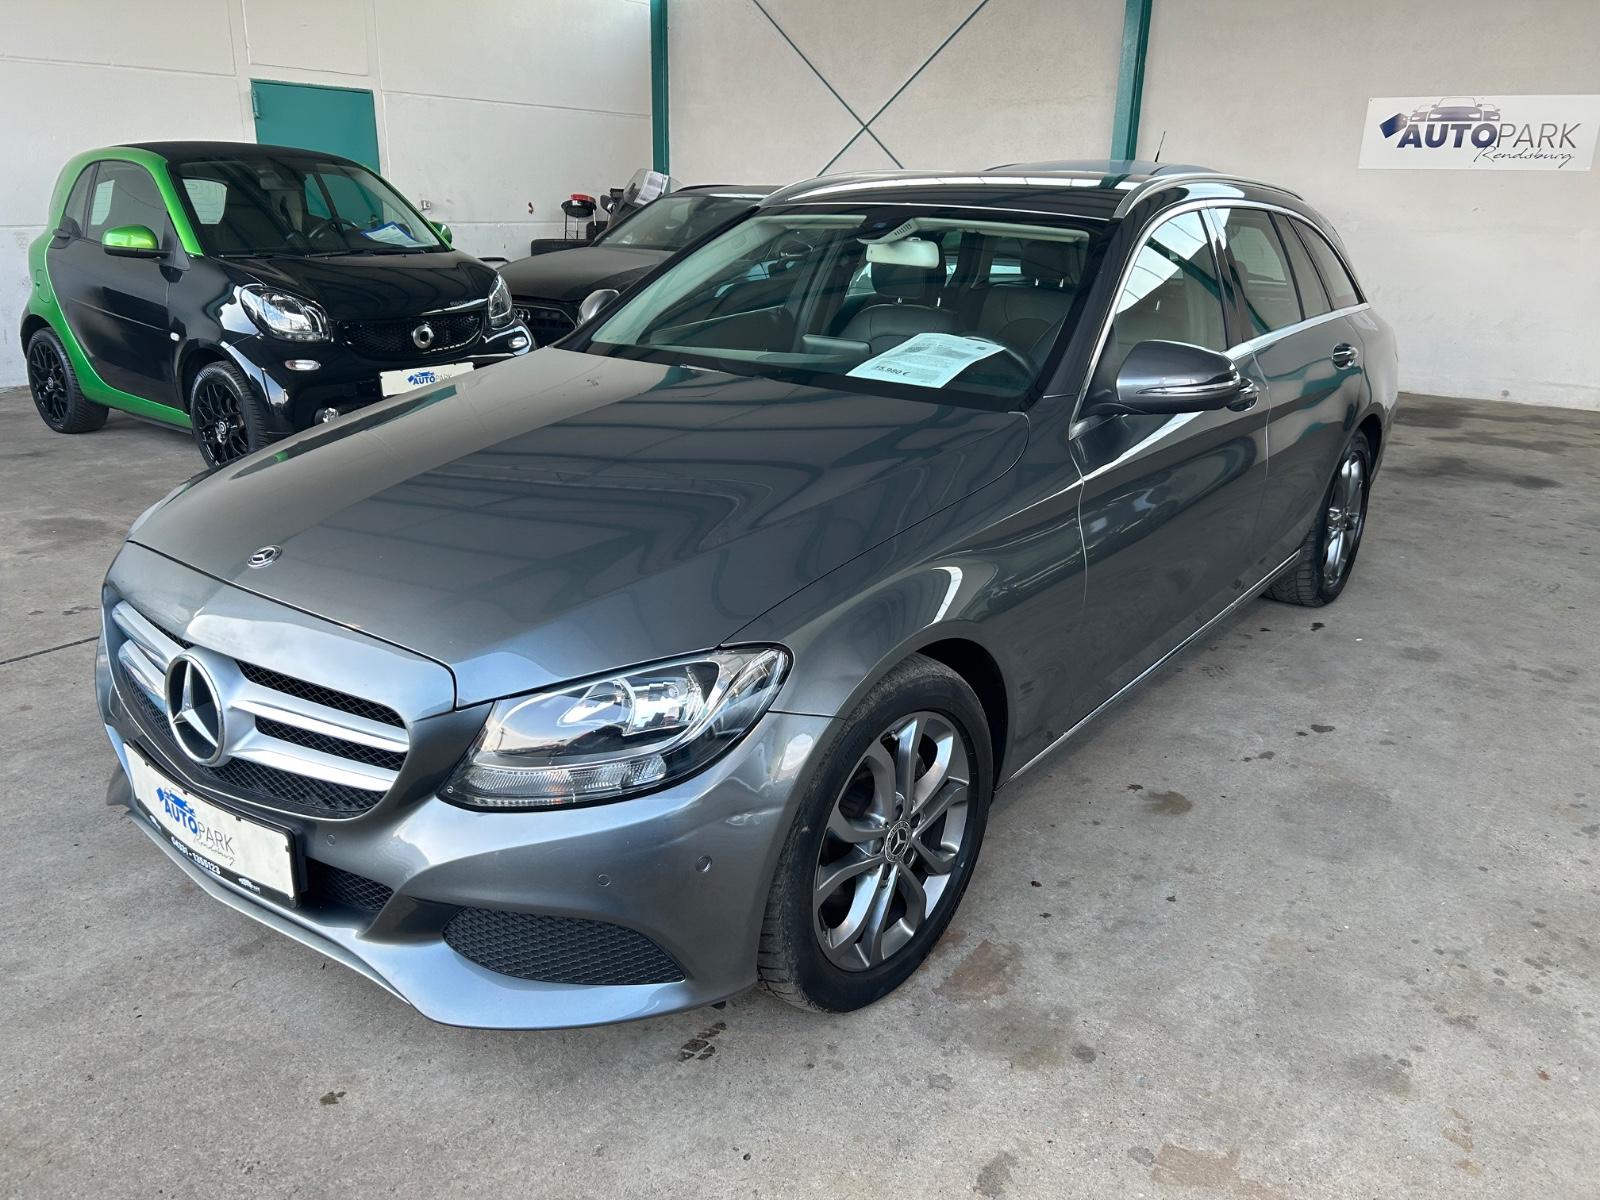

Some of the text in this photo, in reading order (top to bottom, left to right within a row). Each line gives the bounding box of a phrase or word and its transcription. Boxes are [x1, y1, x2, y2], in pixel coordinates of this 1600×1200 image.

[1397, 122, 1582, 149] AUTOPARK
[1473, 145, 1575, 168] Rendsburg
[164, 799, 235, 856] AUTOPARK
